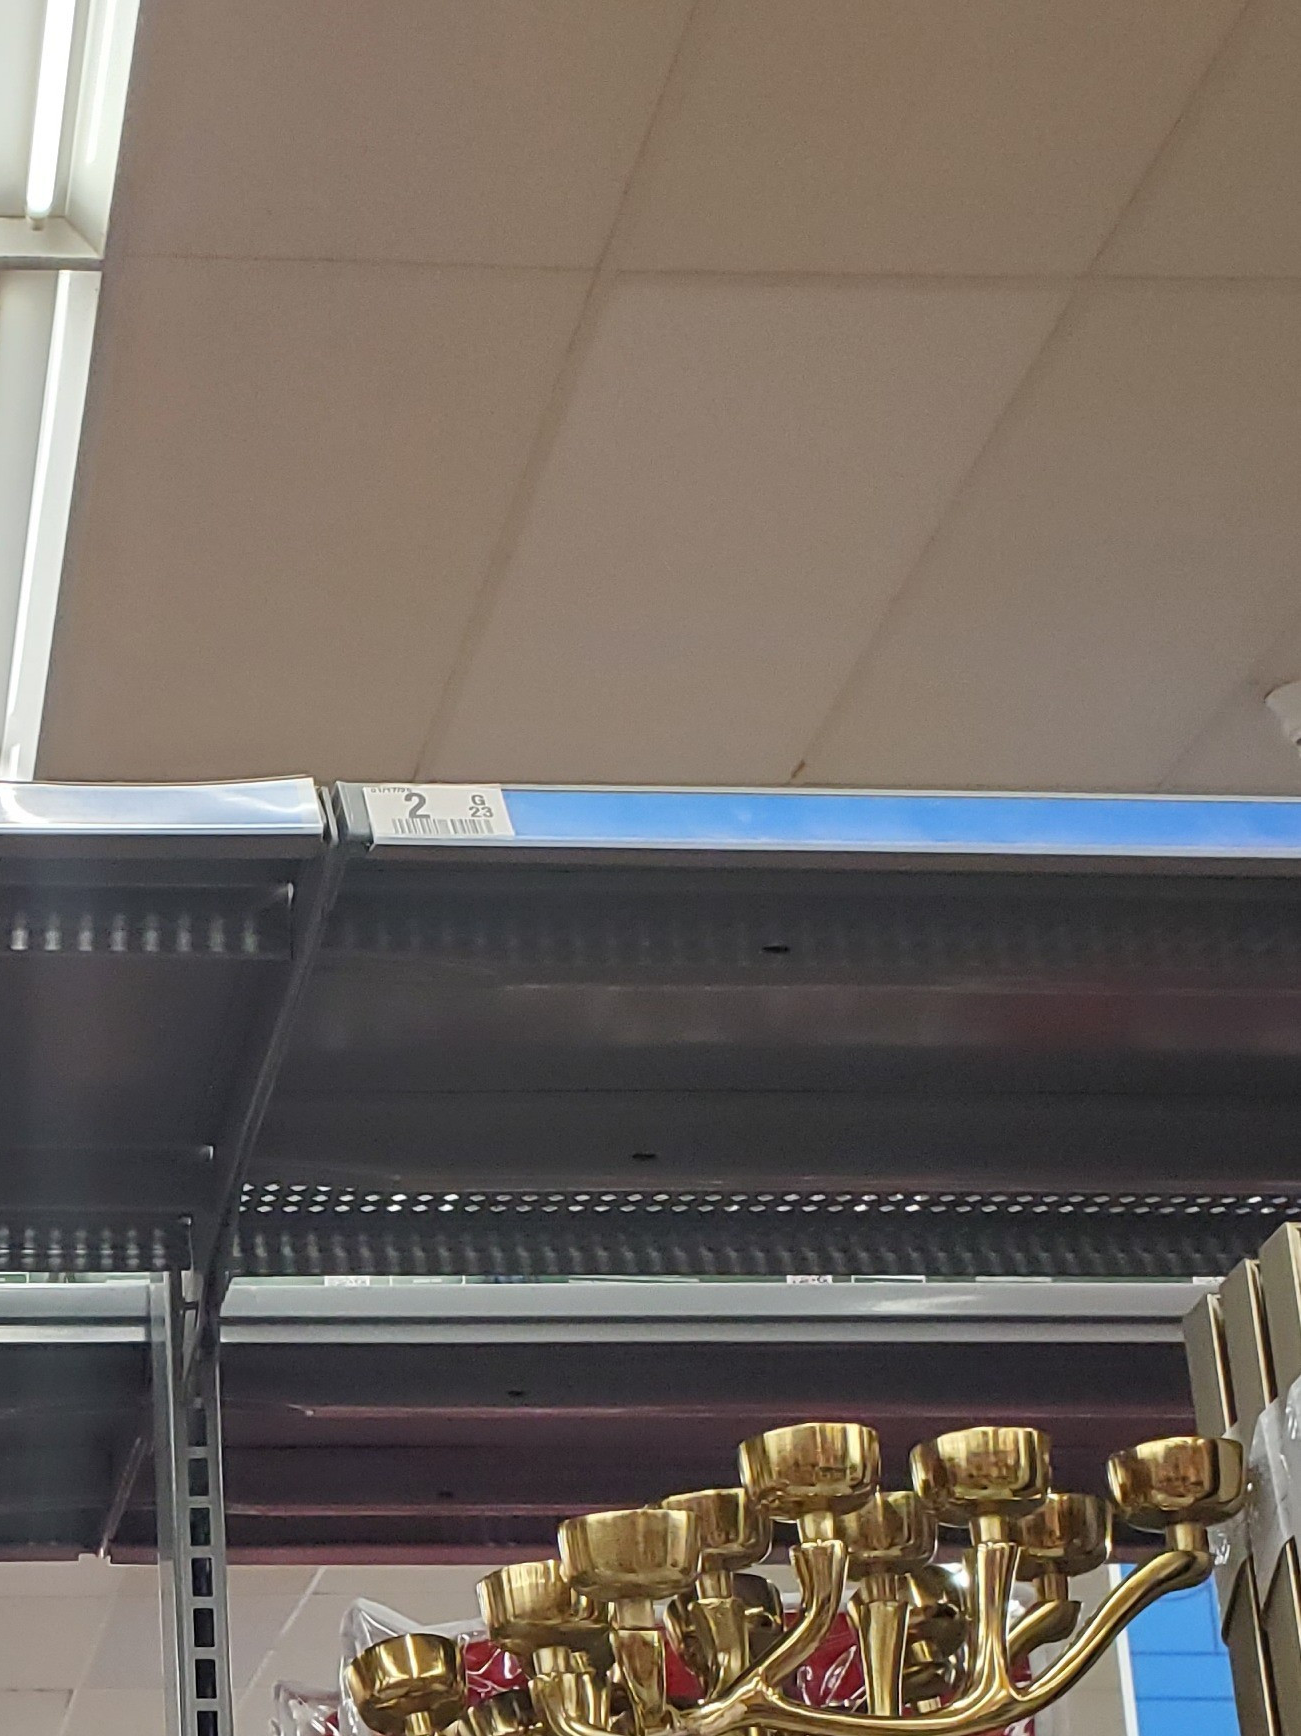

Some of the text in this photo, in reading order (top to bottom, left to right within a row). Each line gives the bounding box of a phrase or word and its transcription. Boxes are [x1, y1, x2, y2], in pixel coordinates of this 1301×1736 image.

[403, 792, 431, 819] 2
[471, 794, 486, 806] G
[468, 806, 494, 818] 23
